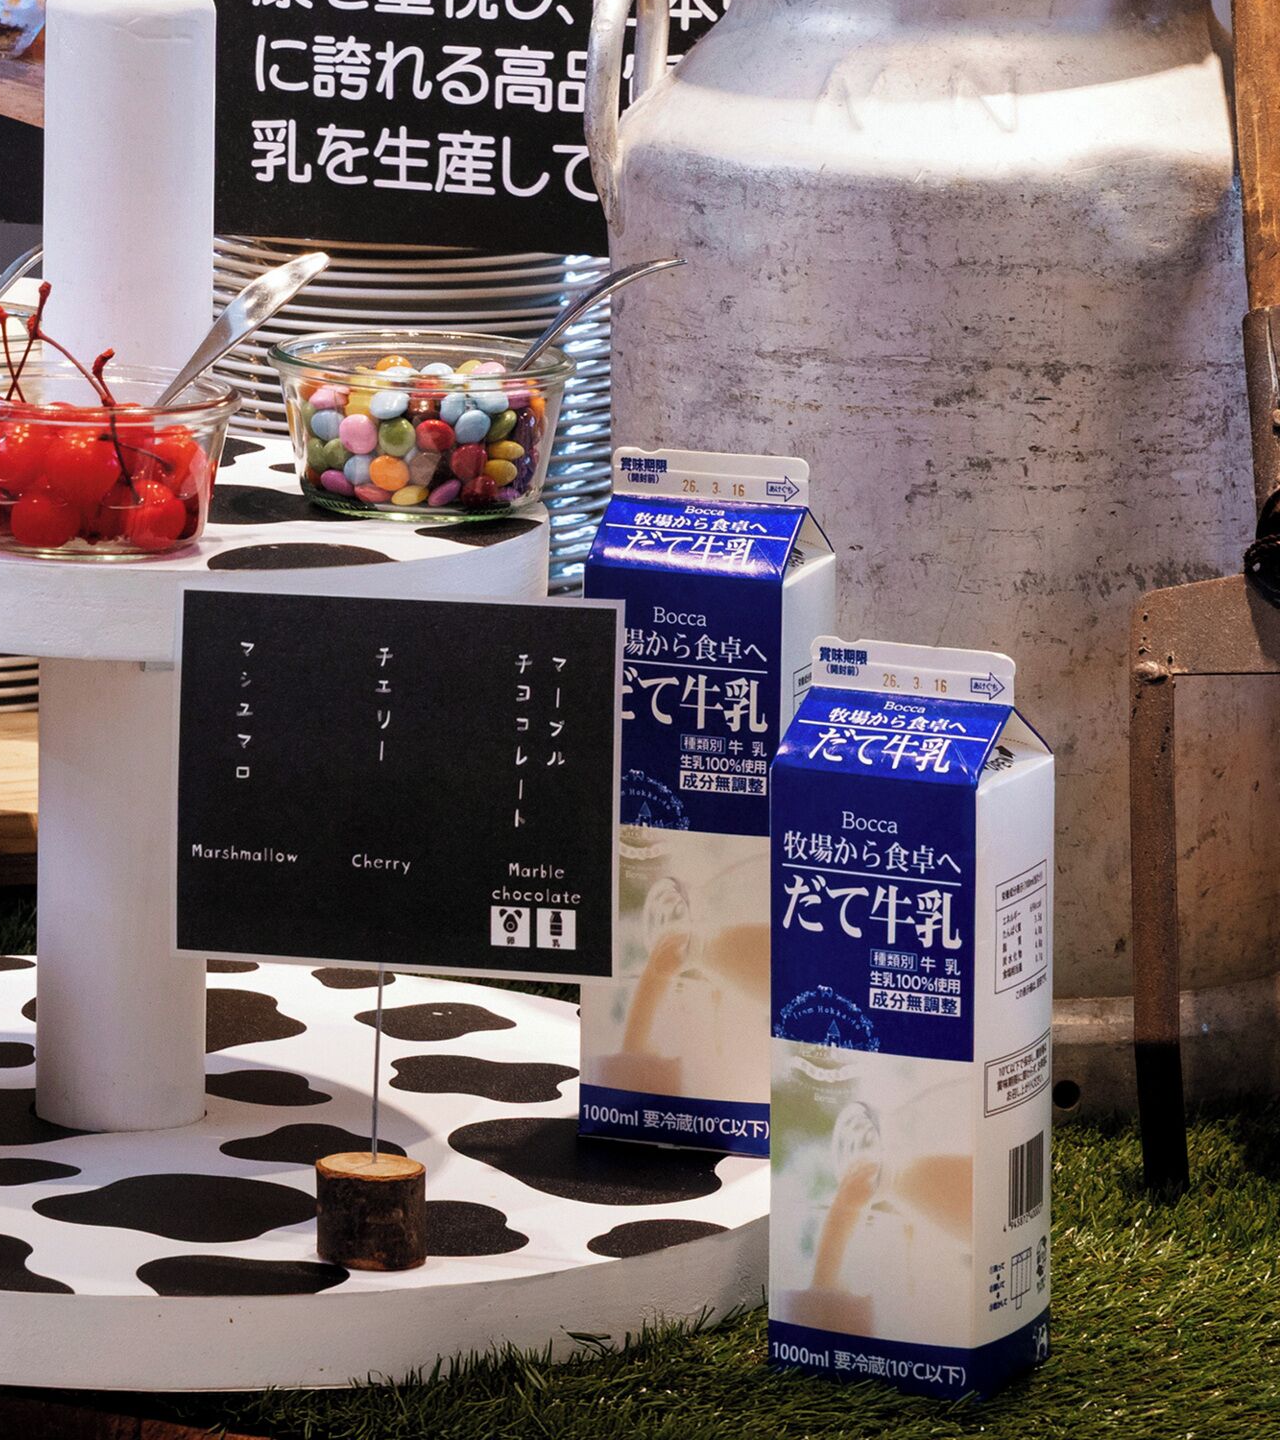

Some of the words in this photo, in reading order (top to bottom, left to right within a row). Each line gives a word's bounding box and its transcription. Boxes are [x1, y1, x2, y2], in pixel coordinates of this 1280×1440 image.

[620, 457, 668, 473] 賞味期限
[732, 483, 745, 497] 16
[685, 505, 726, 517] Bocca
[633, 511, 768, 534] 牧場から食卓へ
[624, 529, 757, 569] だて牛乳
[653, 606, 707, 628] Bocca
[819, 646, 869, 665] 賞味期限
[934, 678, 947, 693] 16
[883, 701, 926, 714] Bocca
[828, 707, 967, 734] 牧場から食卓へ
[683, 738, 723, 753] 種類別
[809, 727, 952, 774] だて牛乳
[680, 754, 767, 776] 生乳100%使用
[682, 774, 764, 794] 成分無調整
[842, 811, 898, 835] Bocca
[191, 843, 298, 864] Marshmallow
[784, 830, 962, 875] 牧場から食卓へ
[352, 853, 412, 875] Cherry
[508, 862, 566, 880] Marble
[491, 887, 582, 905] chocolate
[782, 874, 963, 950] だて牛乳
[873, 951, 914, 969] 種類別
[869, 970, 961, 995] 生乳100%使用
[871, 991, 959, 1016] 成分無調整
[582, 1104, 639, 1127] 1000ml
[772, 1341, 829, 1366] 1000ml
